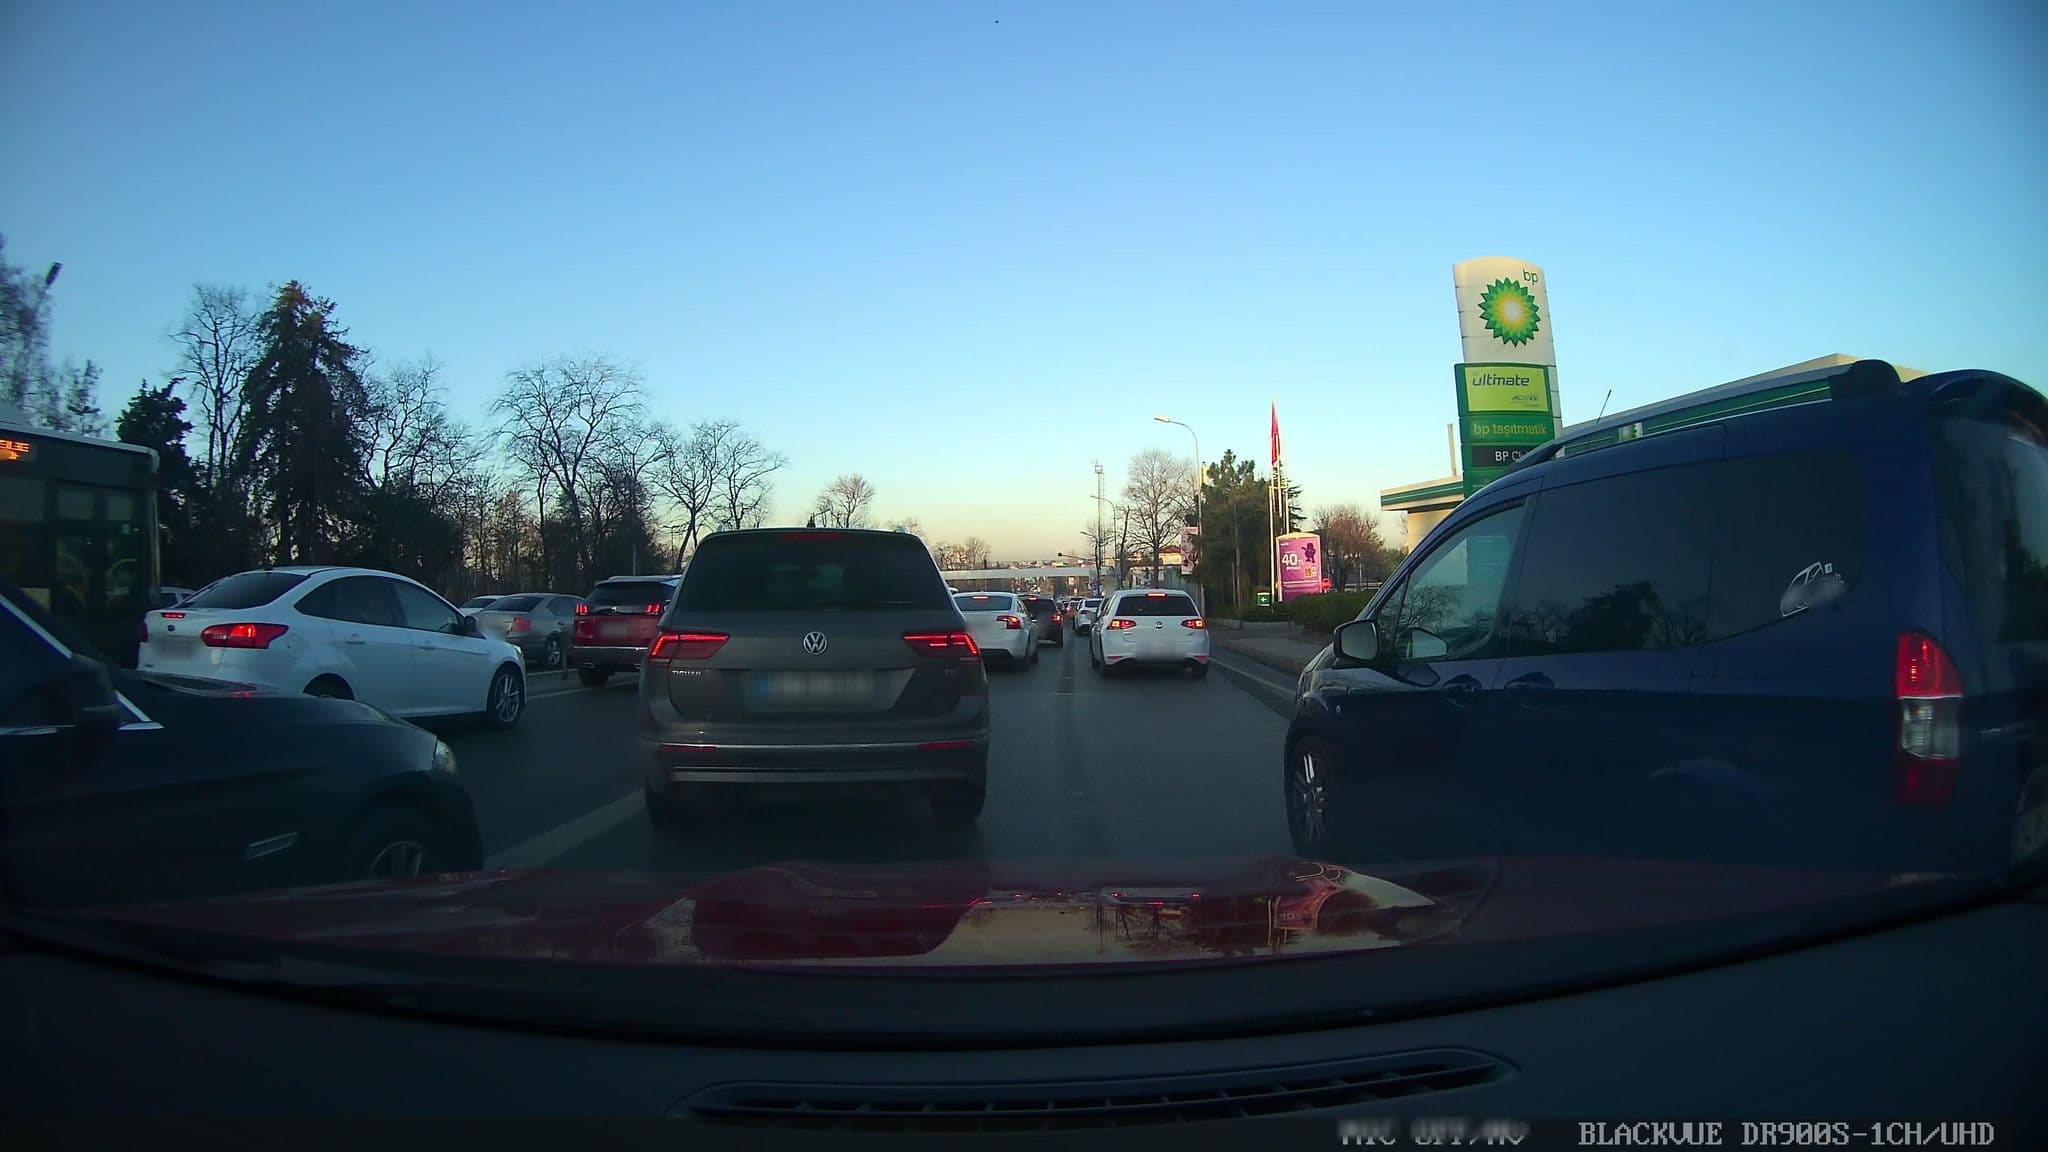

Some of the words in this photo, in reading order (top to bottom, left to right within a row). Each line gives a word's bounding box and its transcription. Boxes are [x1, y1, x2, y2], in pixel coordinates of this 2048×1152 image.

[1523, 269, 1539, 284] bp
[1472, 373, 1530, 387] ultimate
[1473, 423, 1490, 437] bp
[1495, 450, 1509, 462] BP
[1282, 554, 1297, 565] 40
